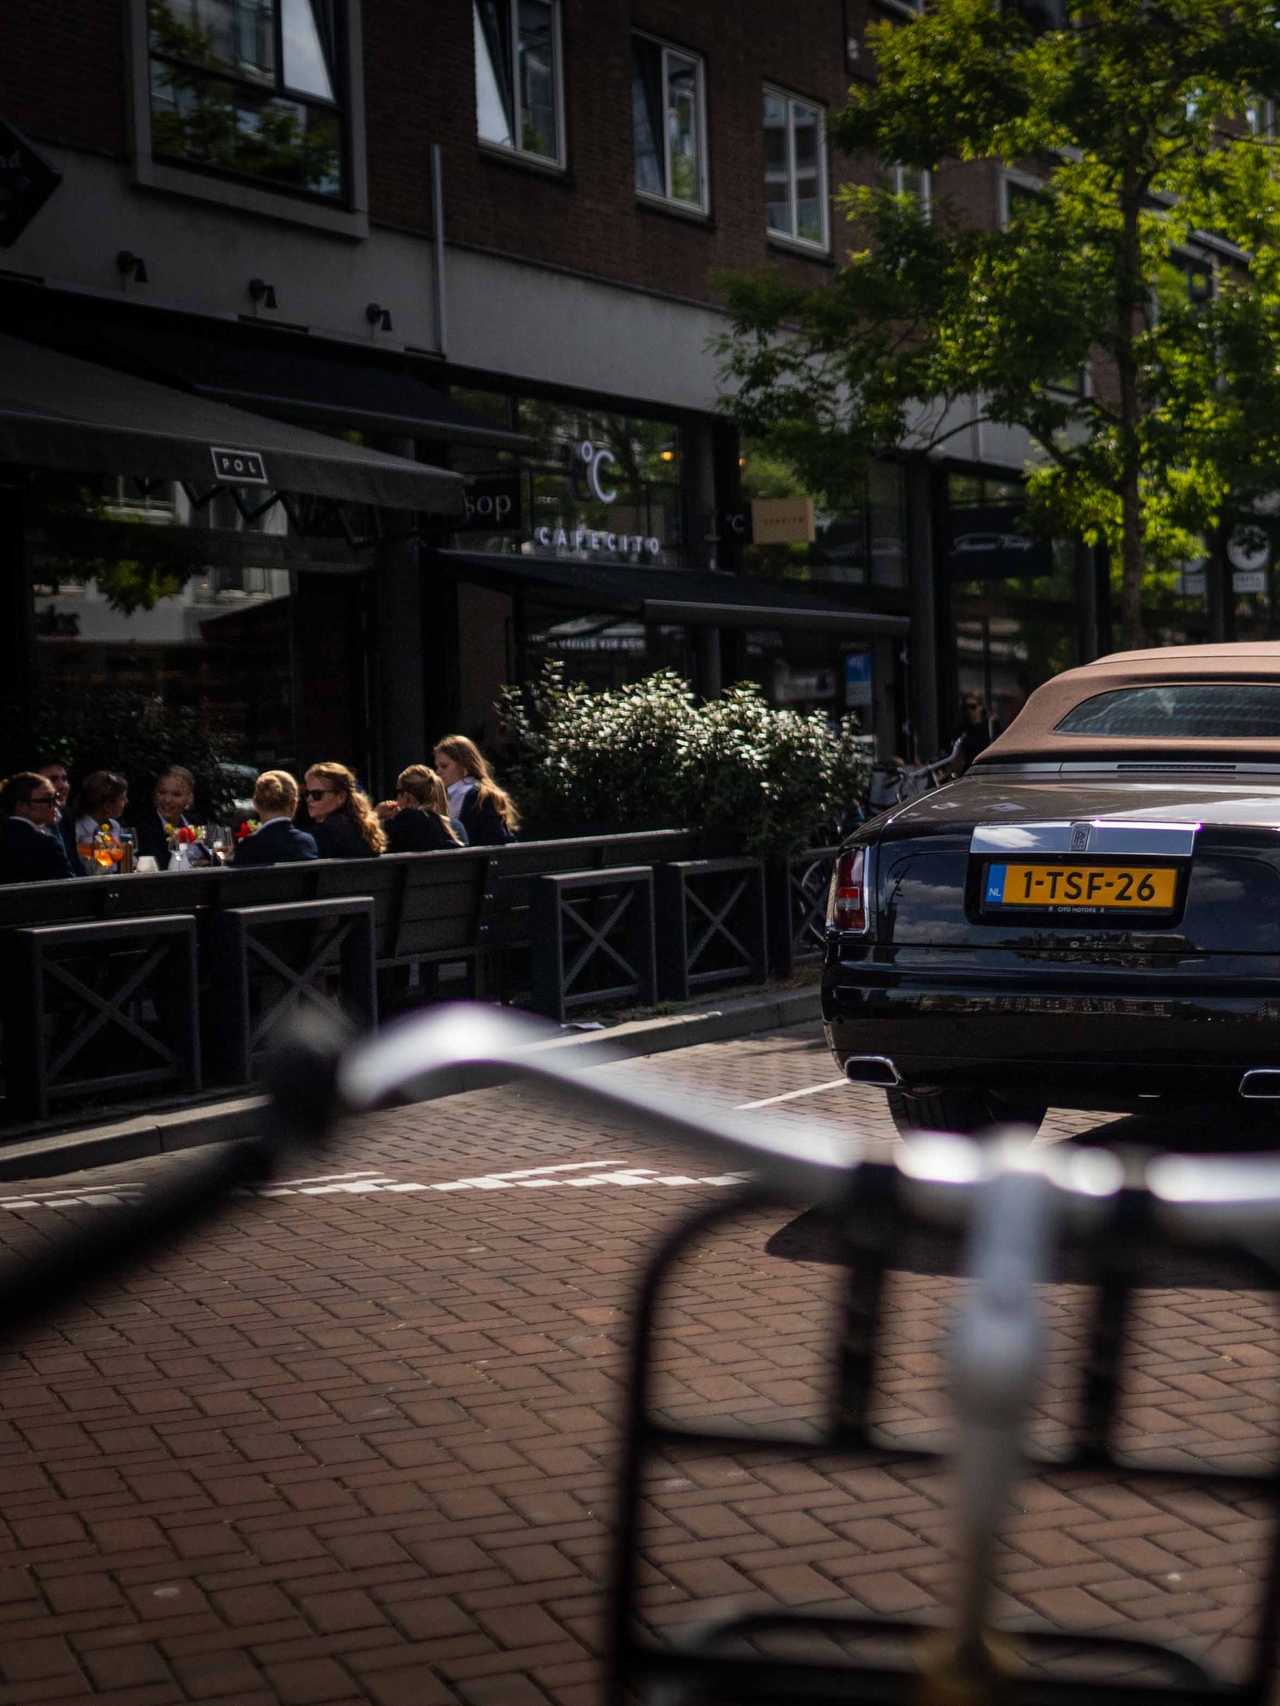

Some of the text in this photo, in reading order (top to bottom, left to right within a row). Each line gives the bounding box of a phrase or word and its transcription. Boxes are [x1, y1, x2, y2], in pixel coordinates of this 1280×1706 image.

[221, 457, 257, 475] POL
[539, 526, 661, 556] CAFECITO
[988, 887, 1001, 897] NL
[1023, 870, 1155, 901] 1-TSF-26
